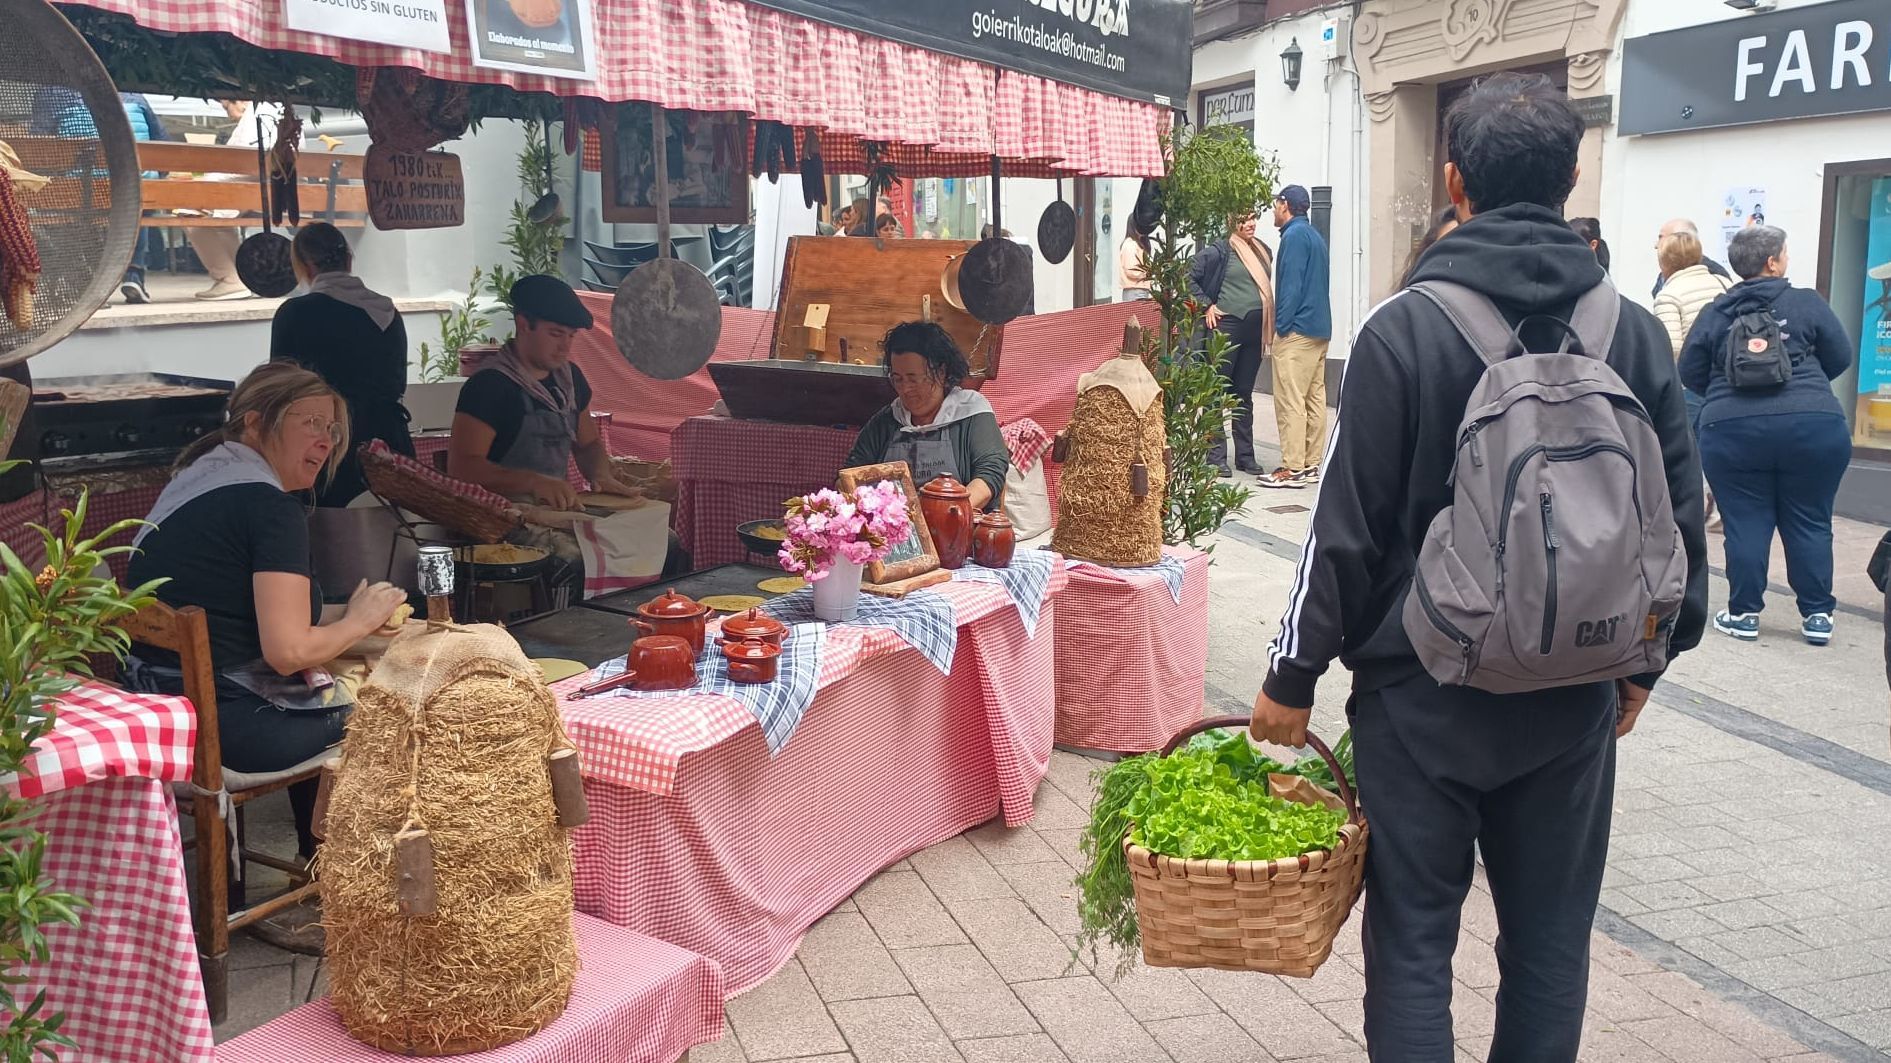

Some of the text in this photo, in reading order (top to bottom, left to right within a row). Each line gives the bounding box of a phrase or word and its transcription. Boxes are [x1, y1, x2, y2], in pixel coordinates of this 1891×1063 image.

[371, 3, 390, 14] SIN
[393, 5, 438, 23] GLUTEN
[1469, 8, 1479, 22] 10
[972, 10, 1125, 72] goierrikotaloak@hotmail.com
[1734, 20, 1891, 102] FAR
[372, 180, 404, 197] TALO
[1575, 615, 1620, 648] CAT
